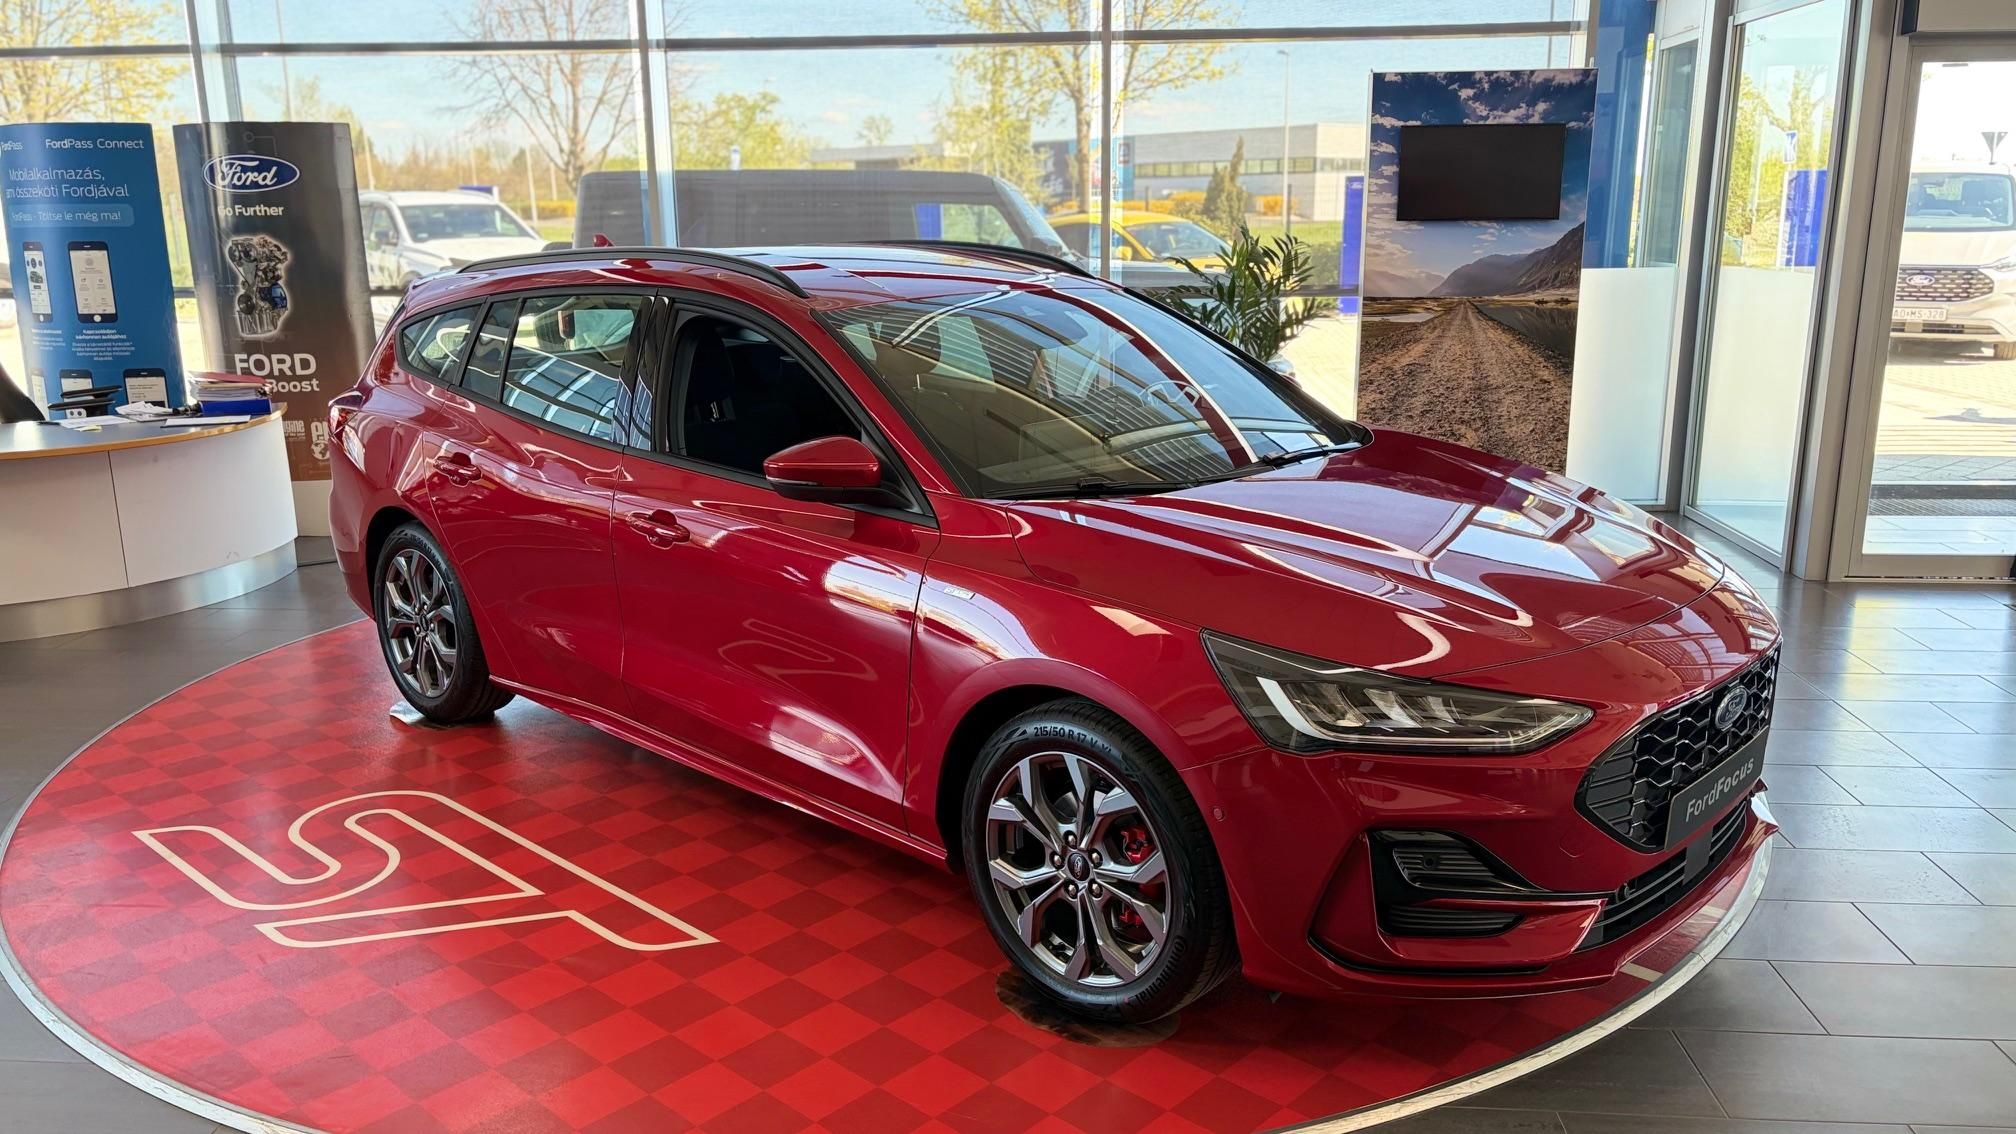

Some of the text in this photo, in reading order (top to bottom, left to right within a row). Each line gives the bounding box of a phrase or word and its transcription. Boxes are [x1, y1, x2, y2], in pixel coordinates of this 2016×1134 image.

[45, 139, 144, 149] FordPass Connect
[217, 156, 278, 186] Ford
[61, 183, 130, 199] Fordjával
[64, 211, 73, 221] le
[75, 210, 99, 222] még
[100, 211, 121, 221] ma!
[217, 204, 284, 217] Go Further
[234, 353, 317, 377] FORD
[1034, 726, 1066, 738] 215/50
[1068, 729, 1075, 739] R
[1077, 733, 1087, 743] 17
[1685, 757, 1755, 823] FordFocus
